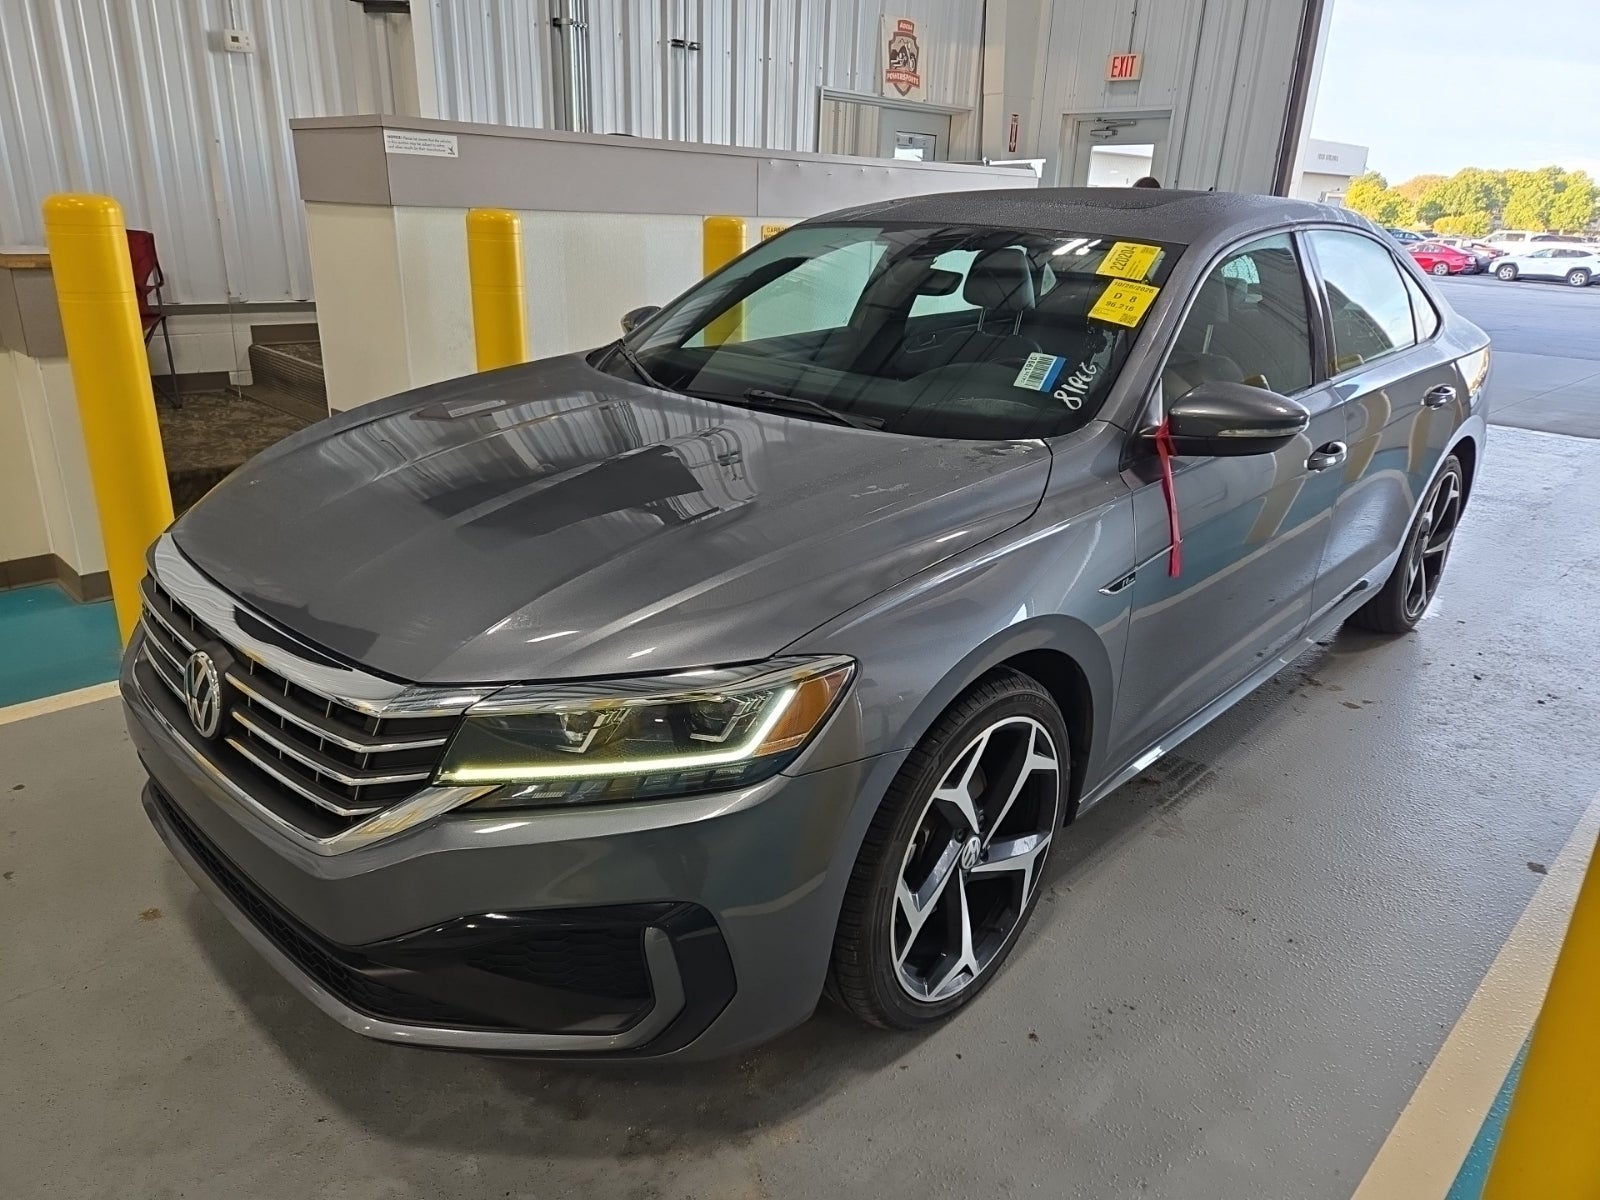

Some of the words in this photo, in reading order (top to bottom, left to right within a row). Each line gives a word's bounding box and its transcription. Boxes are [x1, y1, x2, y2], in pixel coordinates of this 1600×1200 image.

[1110, 55, 1137, 78] EXIT
[886, 71, 919, 85] POWERSPORTS
[1113, 292, 1123, 300] D
[1129, 295, 1138, 303] 8
